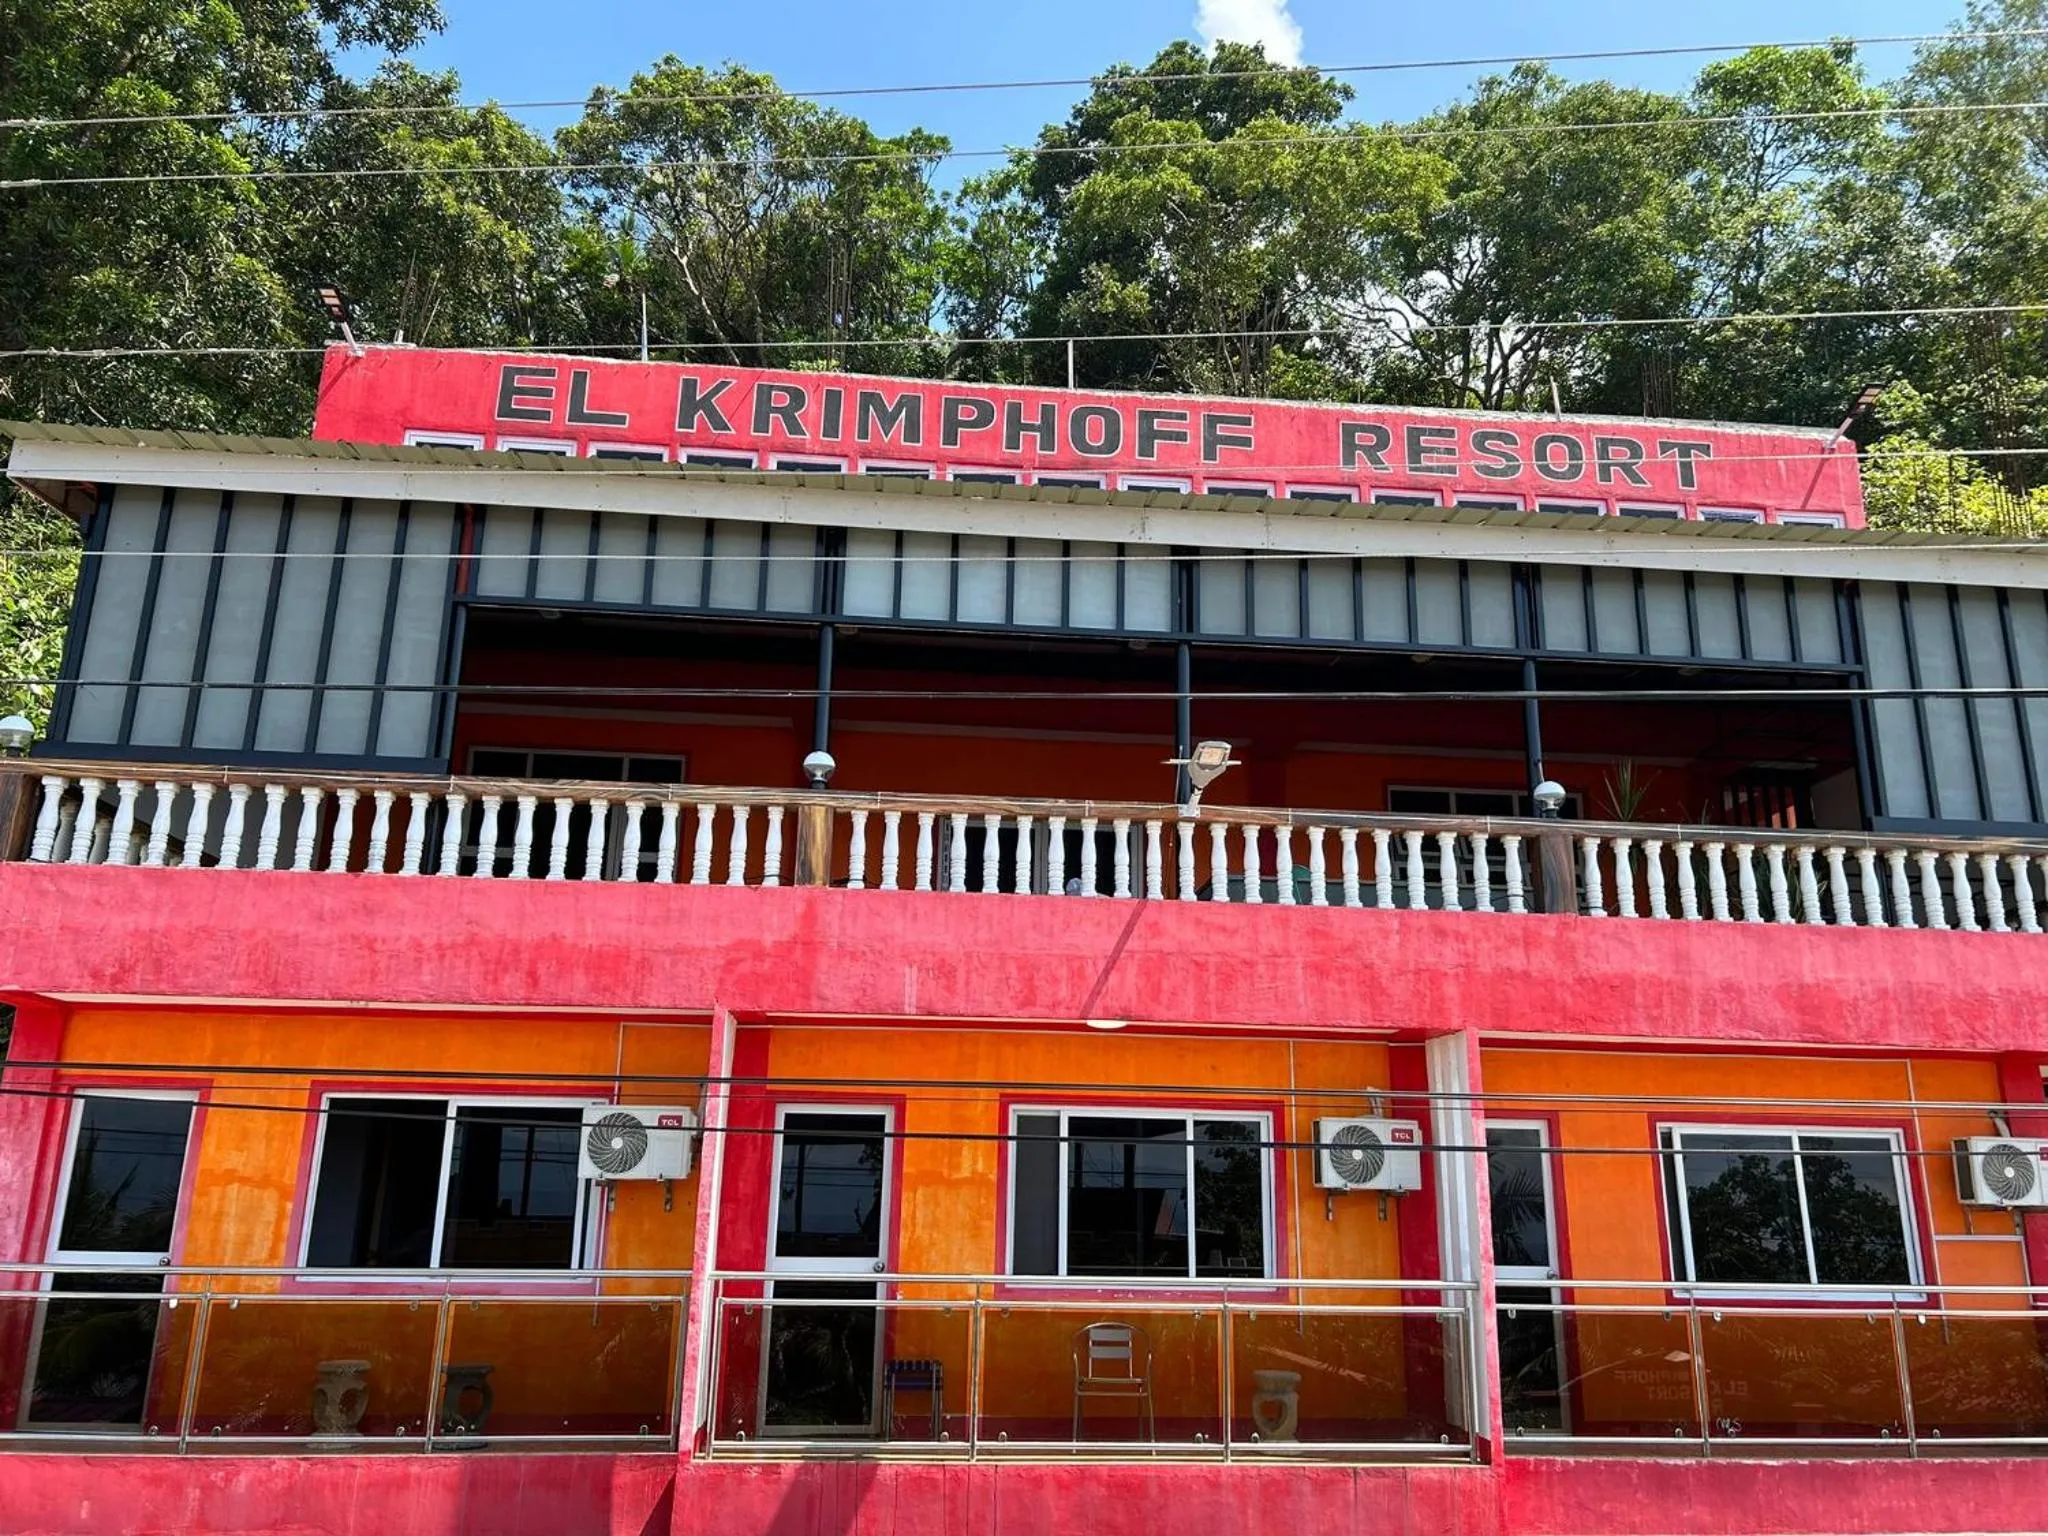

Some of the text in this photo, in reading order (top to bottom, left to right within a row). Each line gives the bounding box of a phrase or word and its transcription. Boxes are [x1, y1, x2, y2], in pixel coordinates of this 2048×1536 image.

[495, 364, 1712, 490] EL KRIMPHOFF RESORT
[660, 1118, 680, 1127] TCL
[1393, 1132, 1412, 1140] TCL
